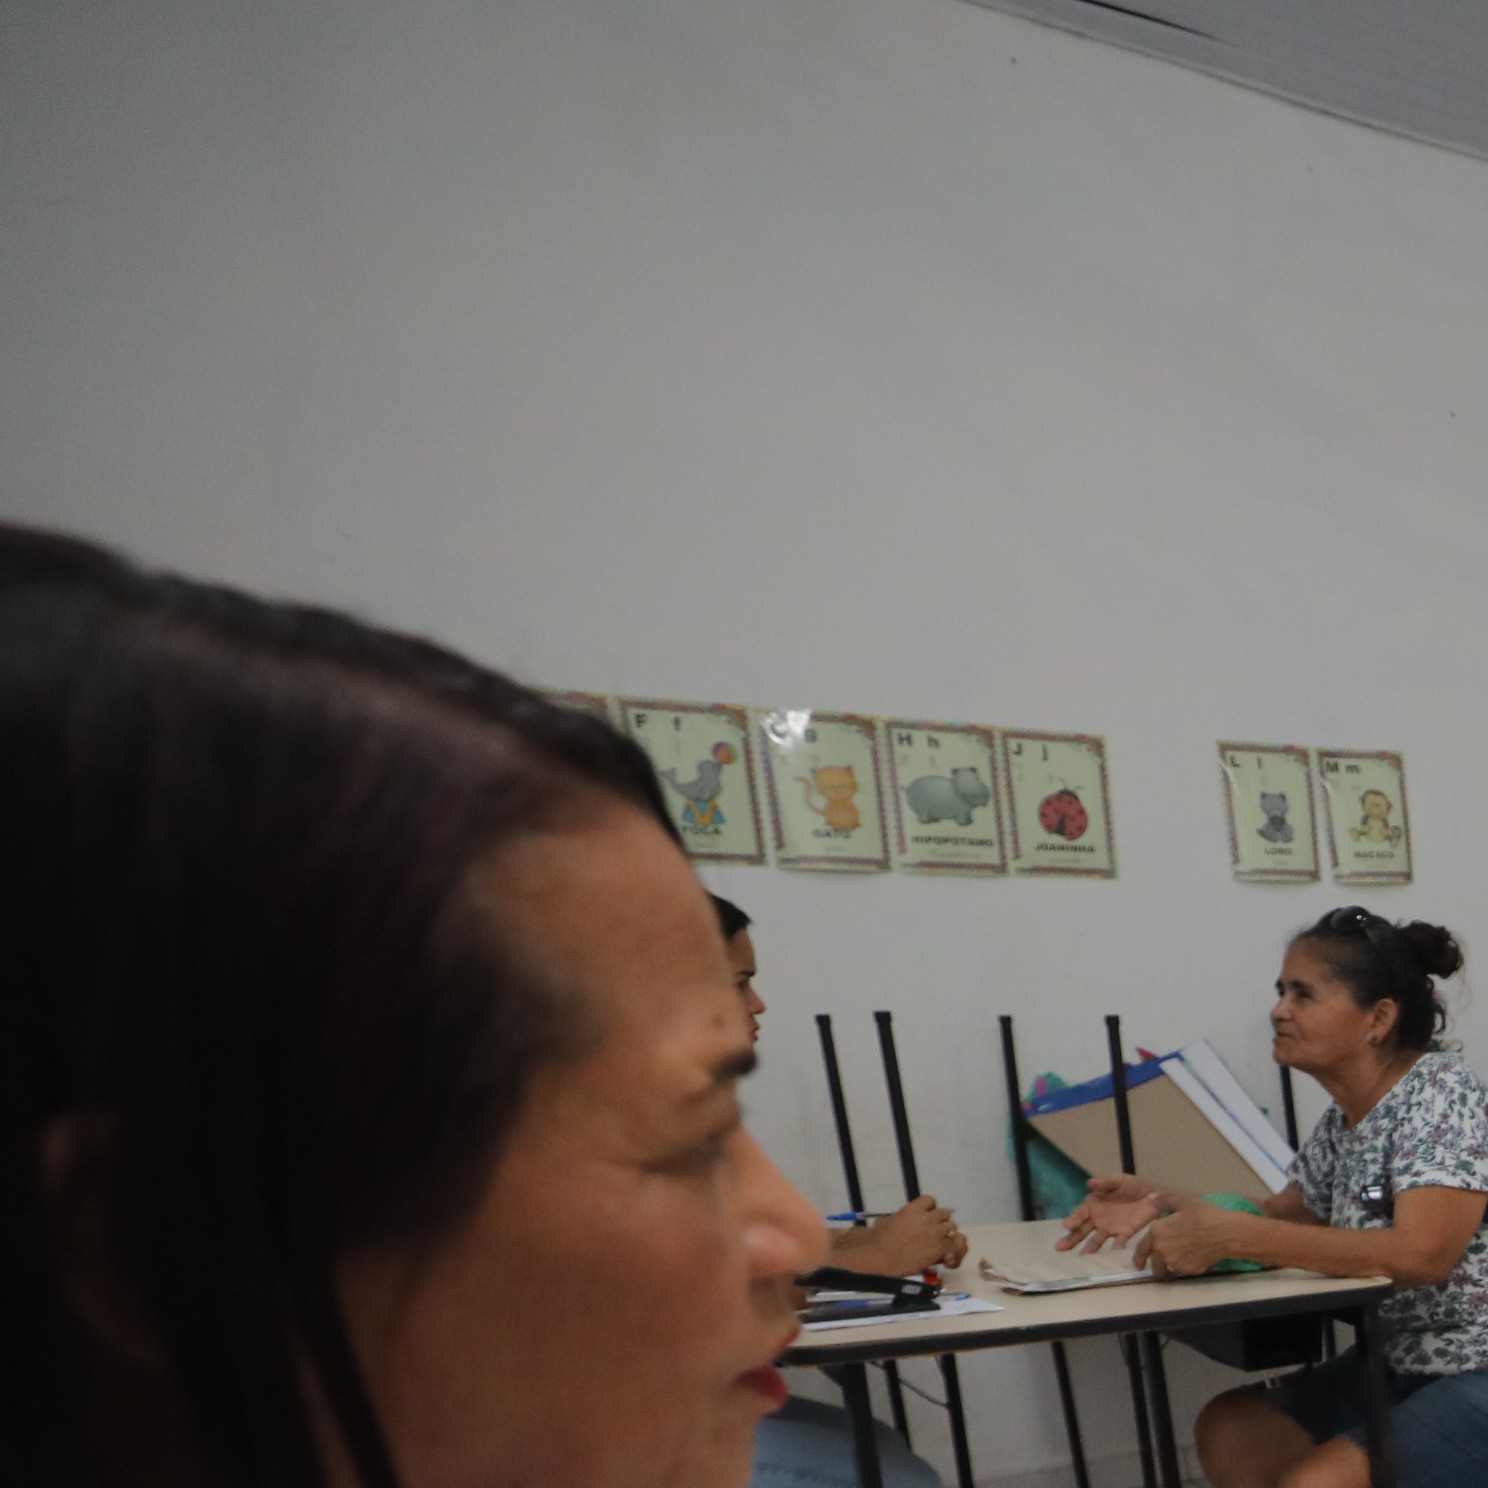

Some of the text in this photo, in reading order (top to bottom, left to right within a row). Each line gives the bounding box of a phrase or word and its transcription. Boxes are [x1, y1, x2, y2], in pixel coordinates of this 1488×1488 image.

[636, 714, 646, 728] F
[899, 733, 940, 749] H h
[1012, 743, 1022, 756] J
[1230, 756, 1240, 768] L
[1325, 761, 1360, 774] M m
